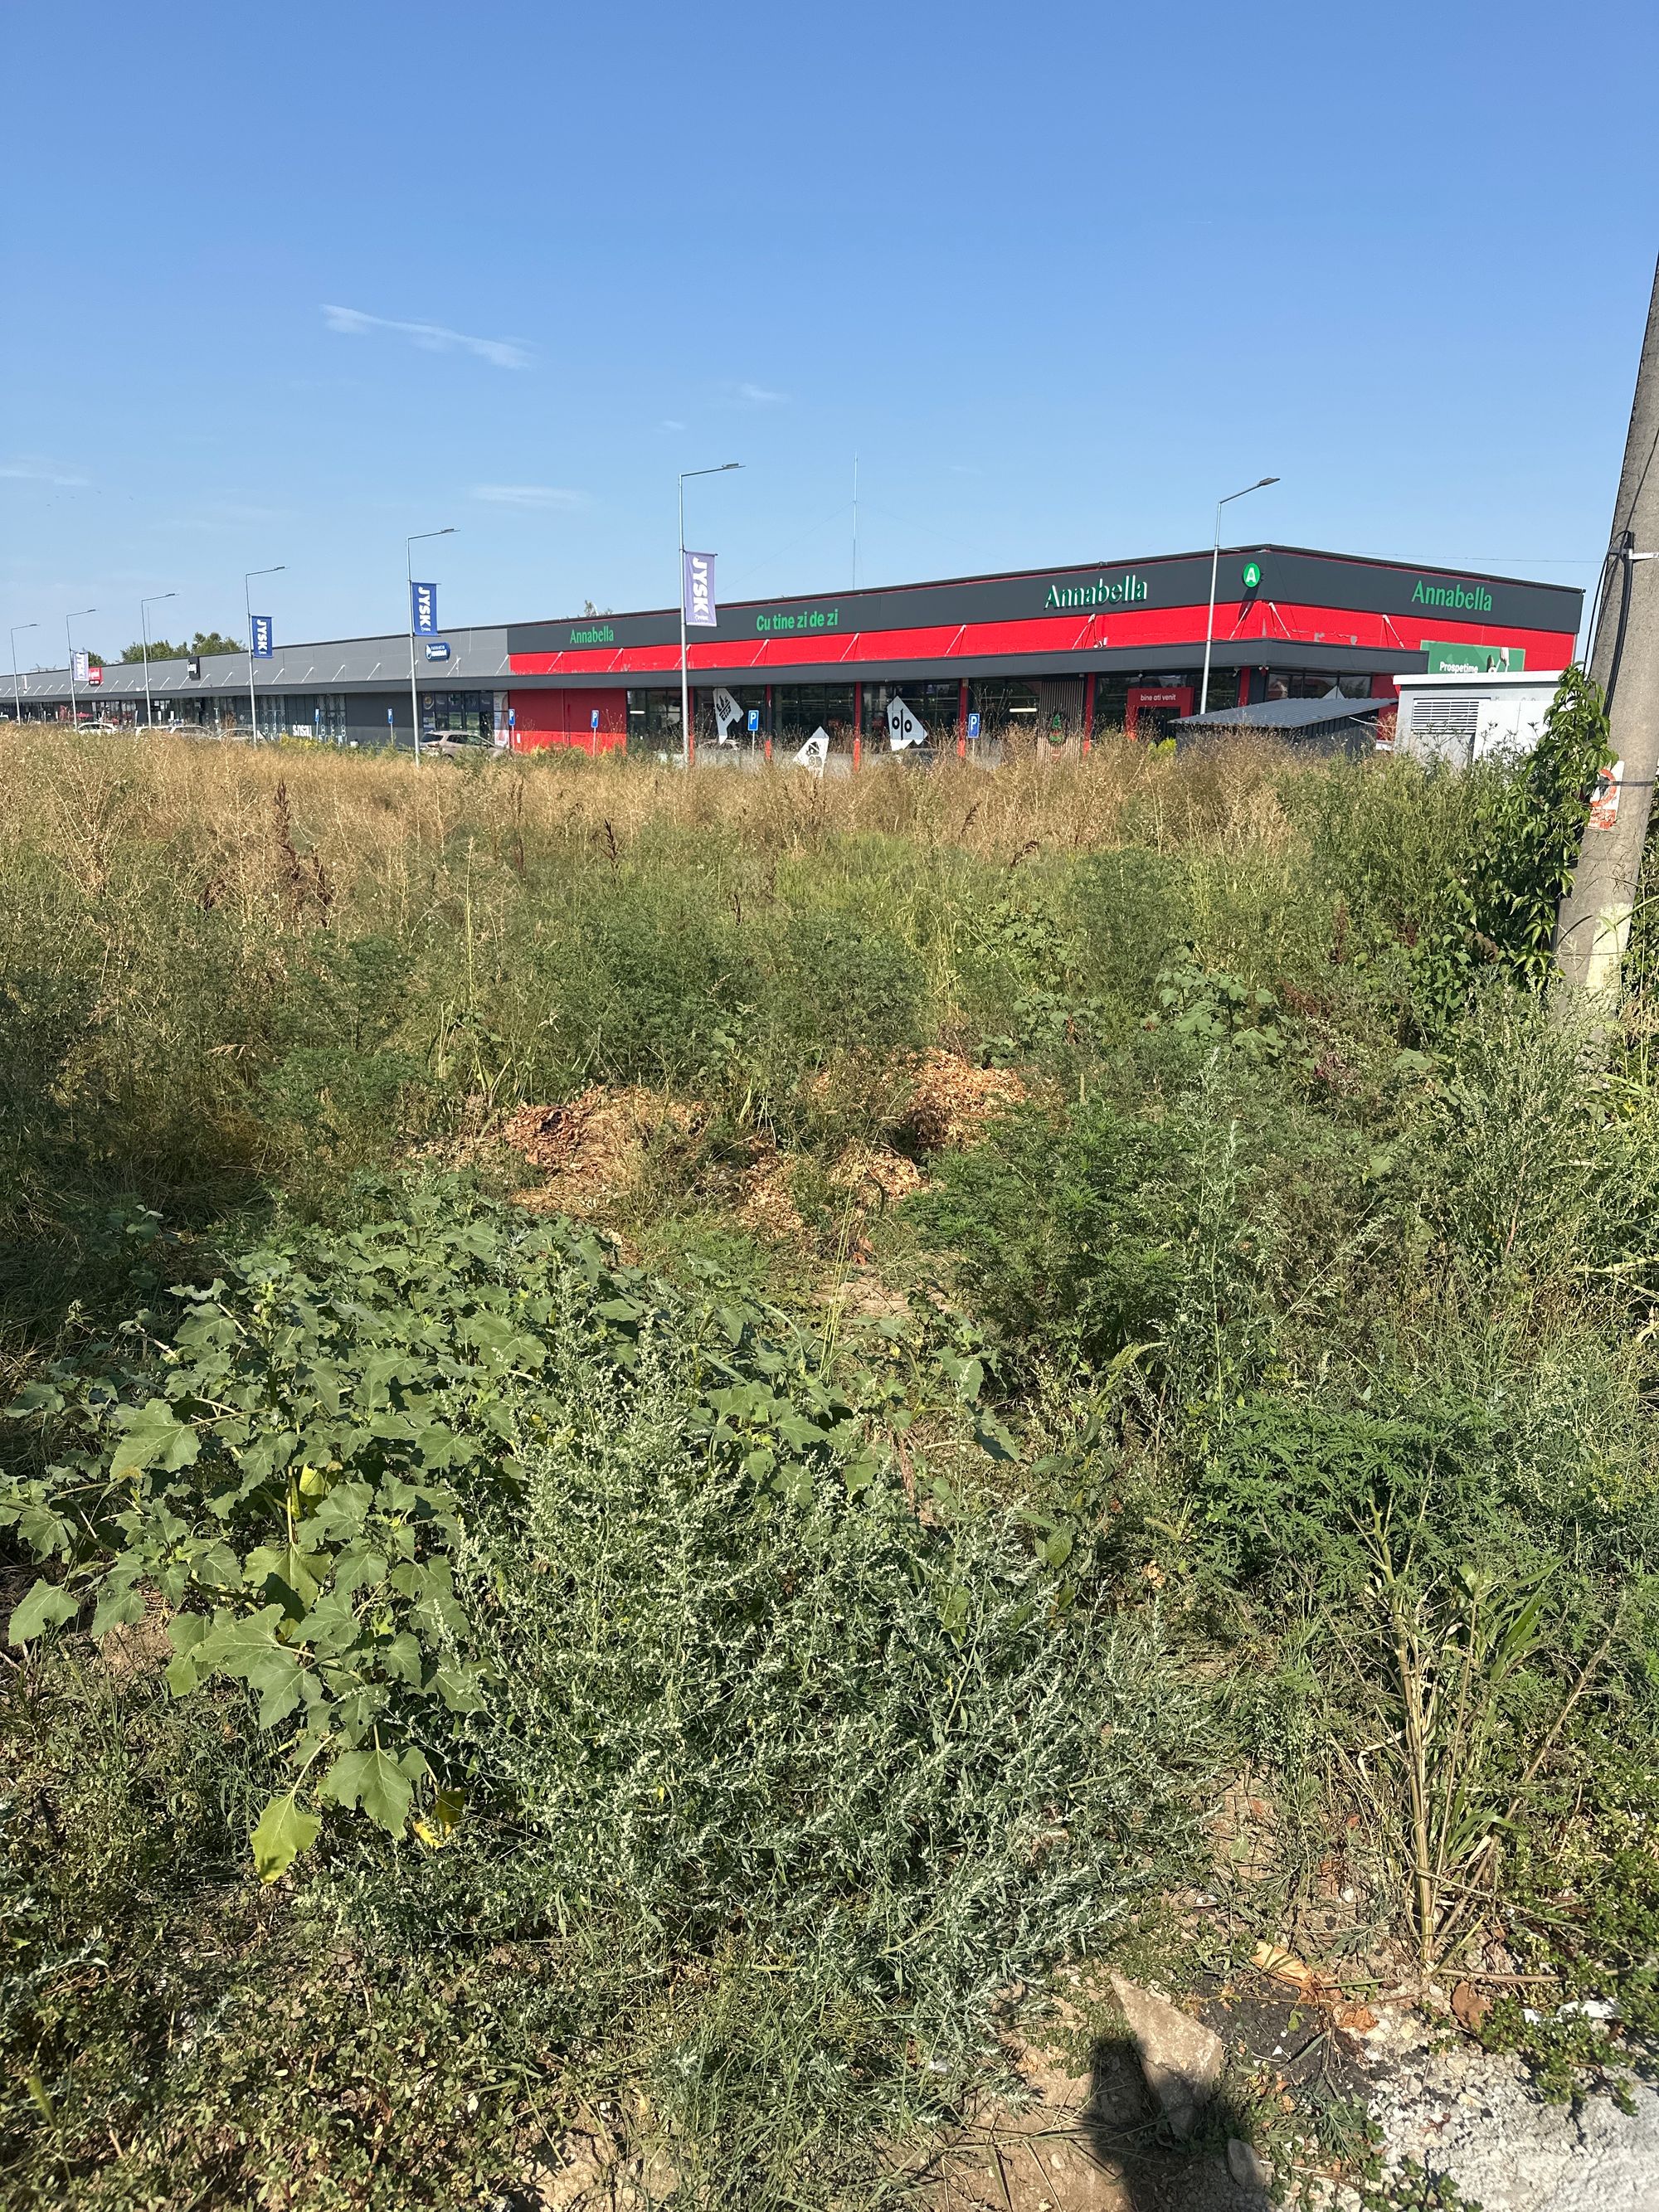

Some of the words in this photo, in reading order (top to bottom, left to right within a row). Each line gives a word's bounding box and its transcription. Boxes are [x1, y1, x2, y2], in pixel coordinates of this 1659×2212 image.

[692, 557, 709, 614] JYSK
[1245, 566, 1257, 583] A
[418, 586, 431, 628] JYSK
[1044, 574, 1148, 609] Annabella
[1411, 579, 1492, 612] Annabella
[256, 619, 268, 651] JYSK
[569, 625, 614, 644] Annabella
[757, 615, 771, 631] Cu
[772, 613, 795, 630] tine
[797, 610, 808, 629] zi
[809, 610, 825, 628] de
[827, 608, 839, 626] zi
[1140, 693, 1153, 702] bine
[1162, 693, 1176, 702] venit
